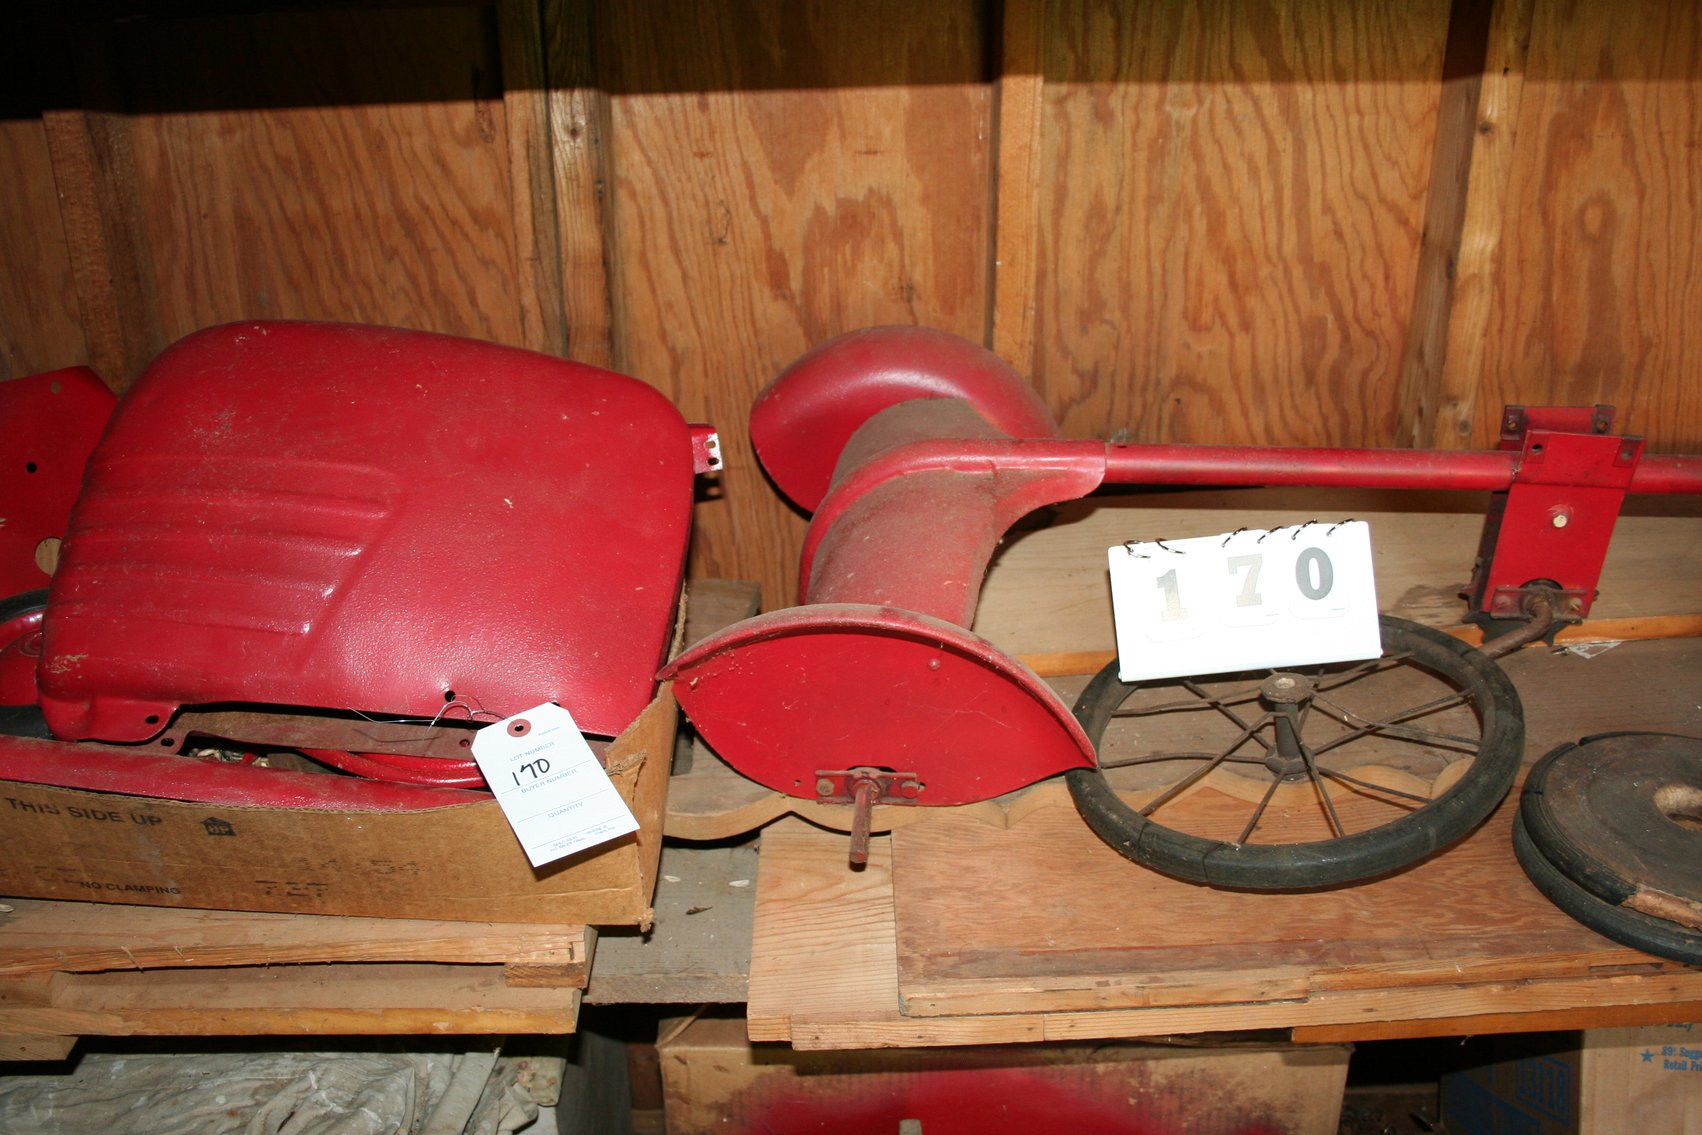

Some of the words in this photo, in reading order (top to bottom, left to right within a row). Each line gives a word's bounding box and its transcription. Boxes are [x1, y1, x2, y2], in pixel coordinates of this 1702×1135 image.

[509, 752, 524, 762] LOT
[525, 741, 555, 756] NUMBER
[512, 758, 551, 786] 170
[520, 780, 545, 794] BUYER
[546, 769, 577, 785] NUMBER
[4, 797, 60, 815] THIS
[63, 806, 125, 823] SIDE
[130, 813, 163, 827] UP
[548, 802, 584, 818] QUANTITY
[79, 880, 102, 889] NO
[104, 882, 181, 895] CLAMPING
[1663, 1059, 1687, 1071] Retail
